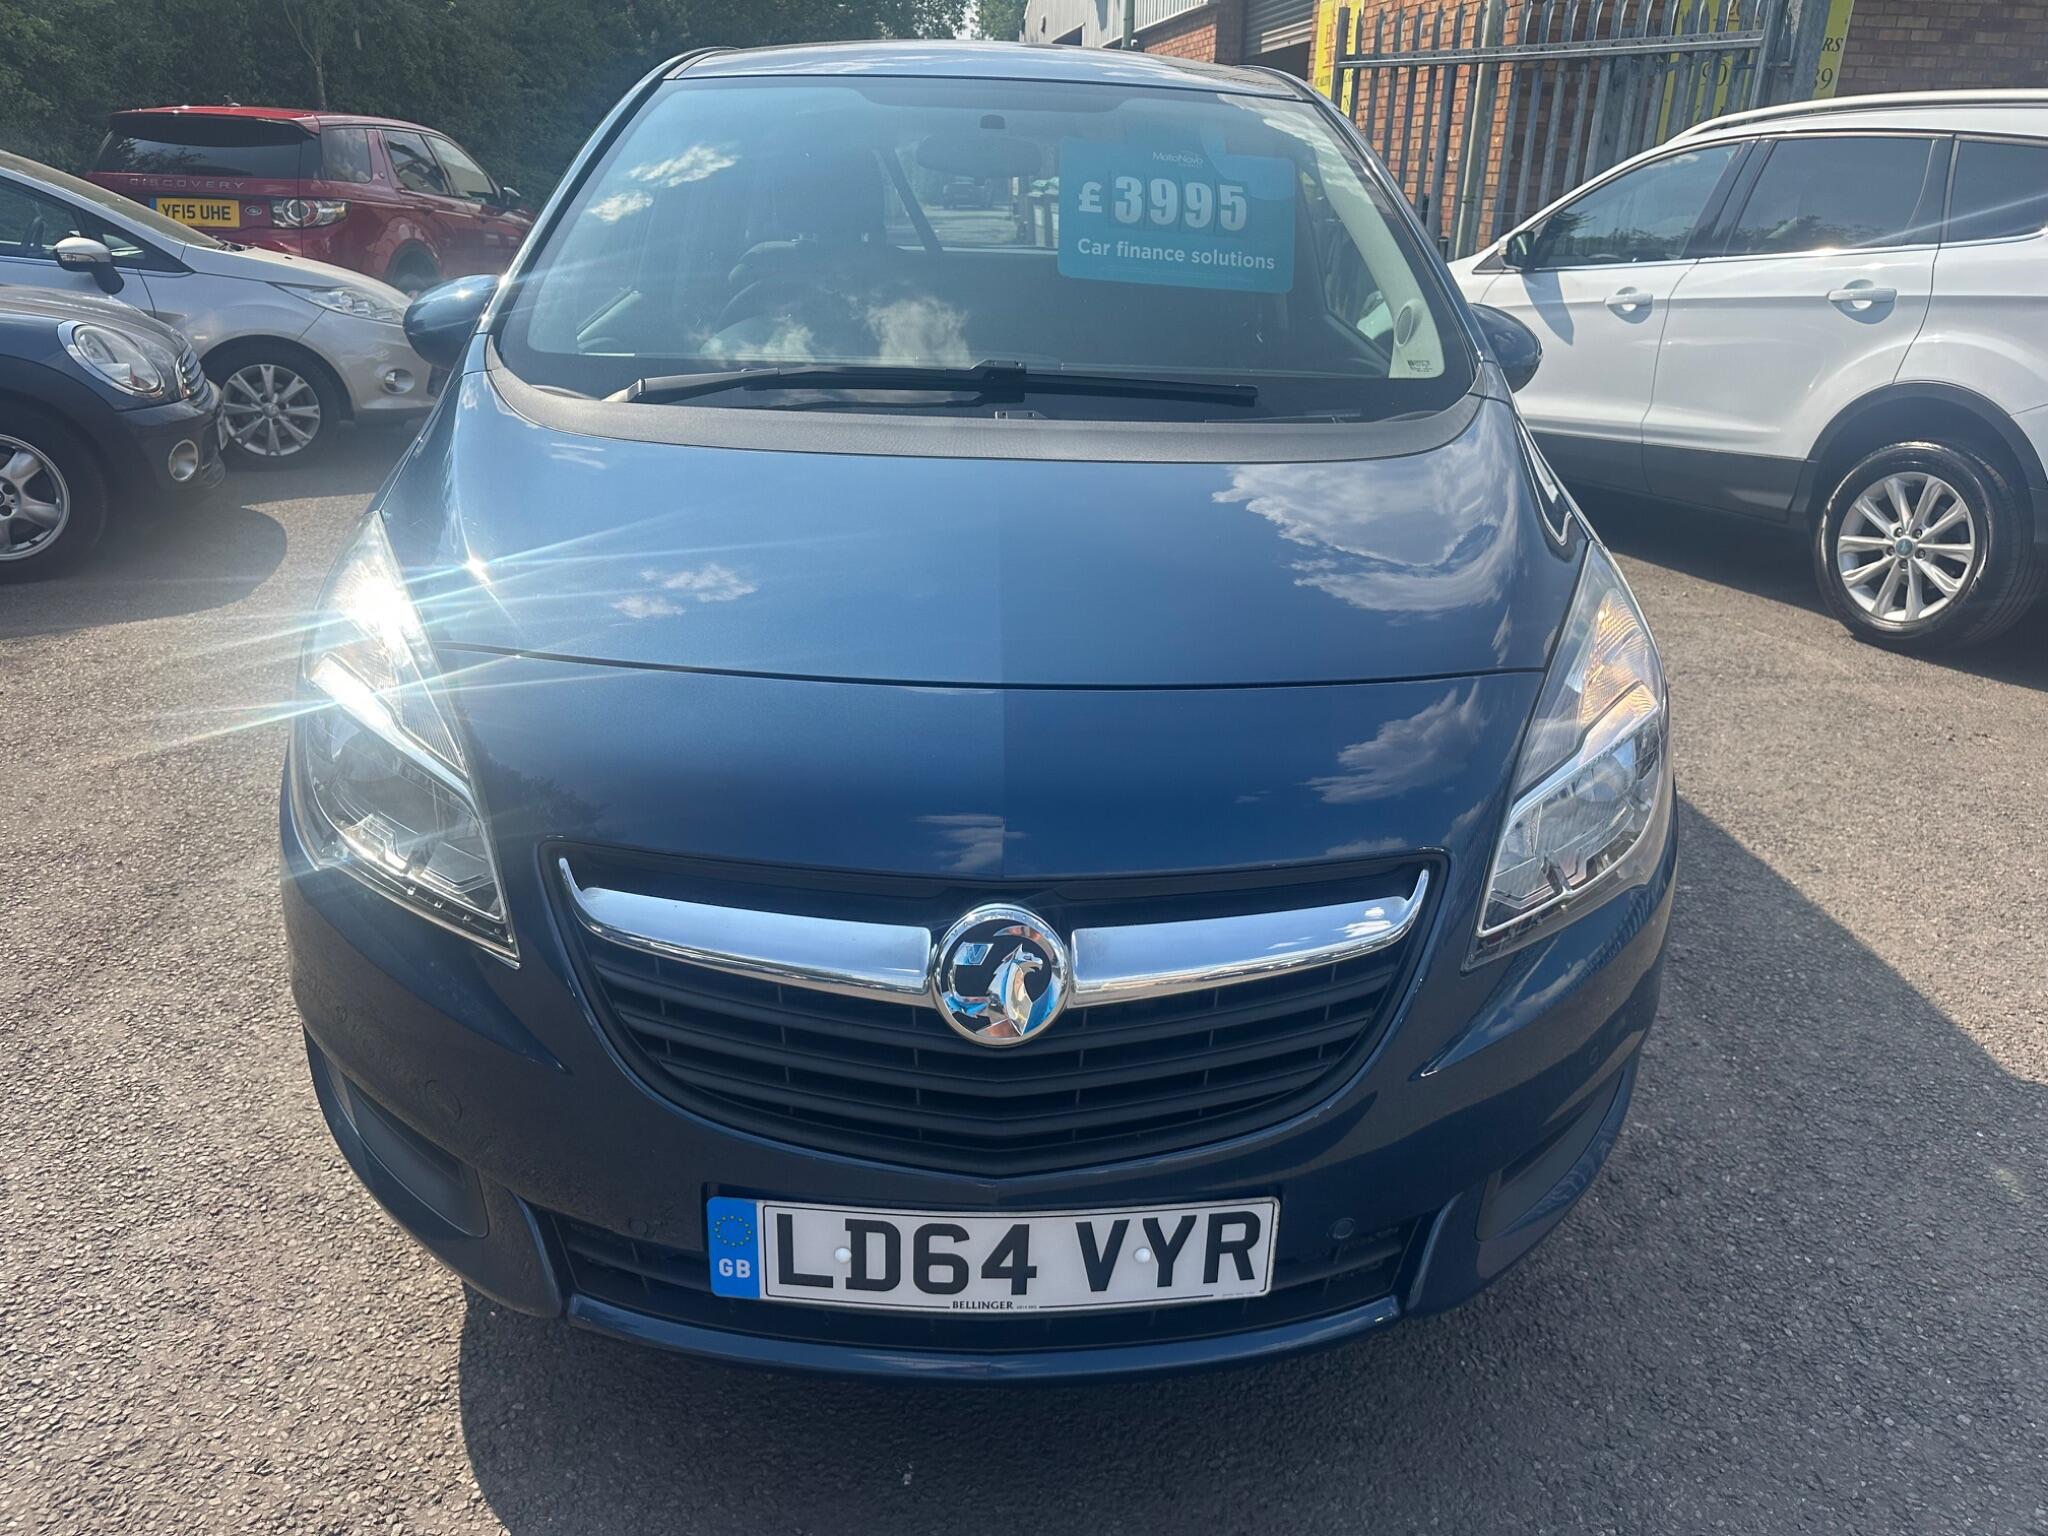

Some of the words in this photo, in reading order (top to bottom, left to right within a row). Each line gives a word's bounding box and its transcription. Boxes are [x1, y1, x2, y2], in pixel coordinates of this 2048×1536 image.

[129, 178, 245, 189] DISCOVERY
[161, 203, 196, 220] YF15
[200, 205, 232, 221] UHE
[1077, 238, 1111, 257] Car
[1115, 240, 1186, 263] finance
[1191, 249, 1276, 270] solutions
[776, 1212, 1038, 1296] LD64
[1075, 1210, 1262, 1293] VYR
[718, 1258, 751, 1278] GB
[952, 1300, 1014, 1310] BELLINGER
